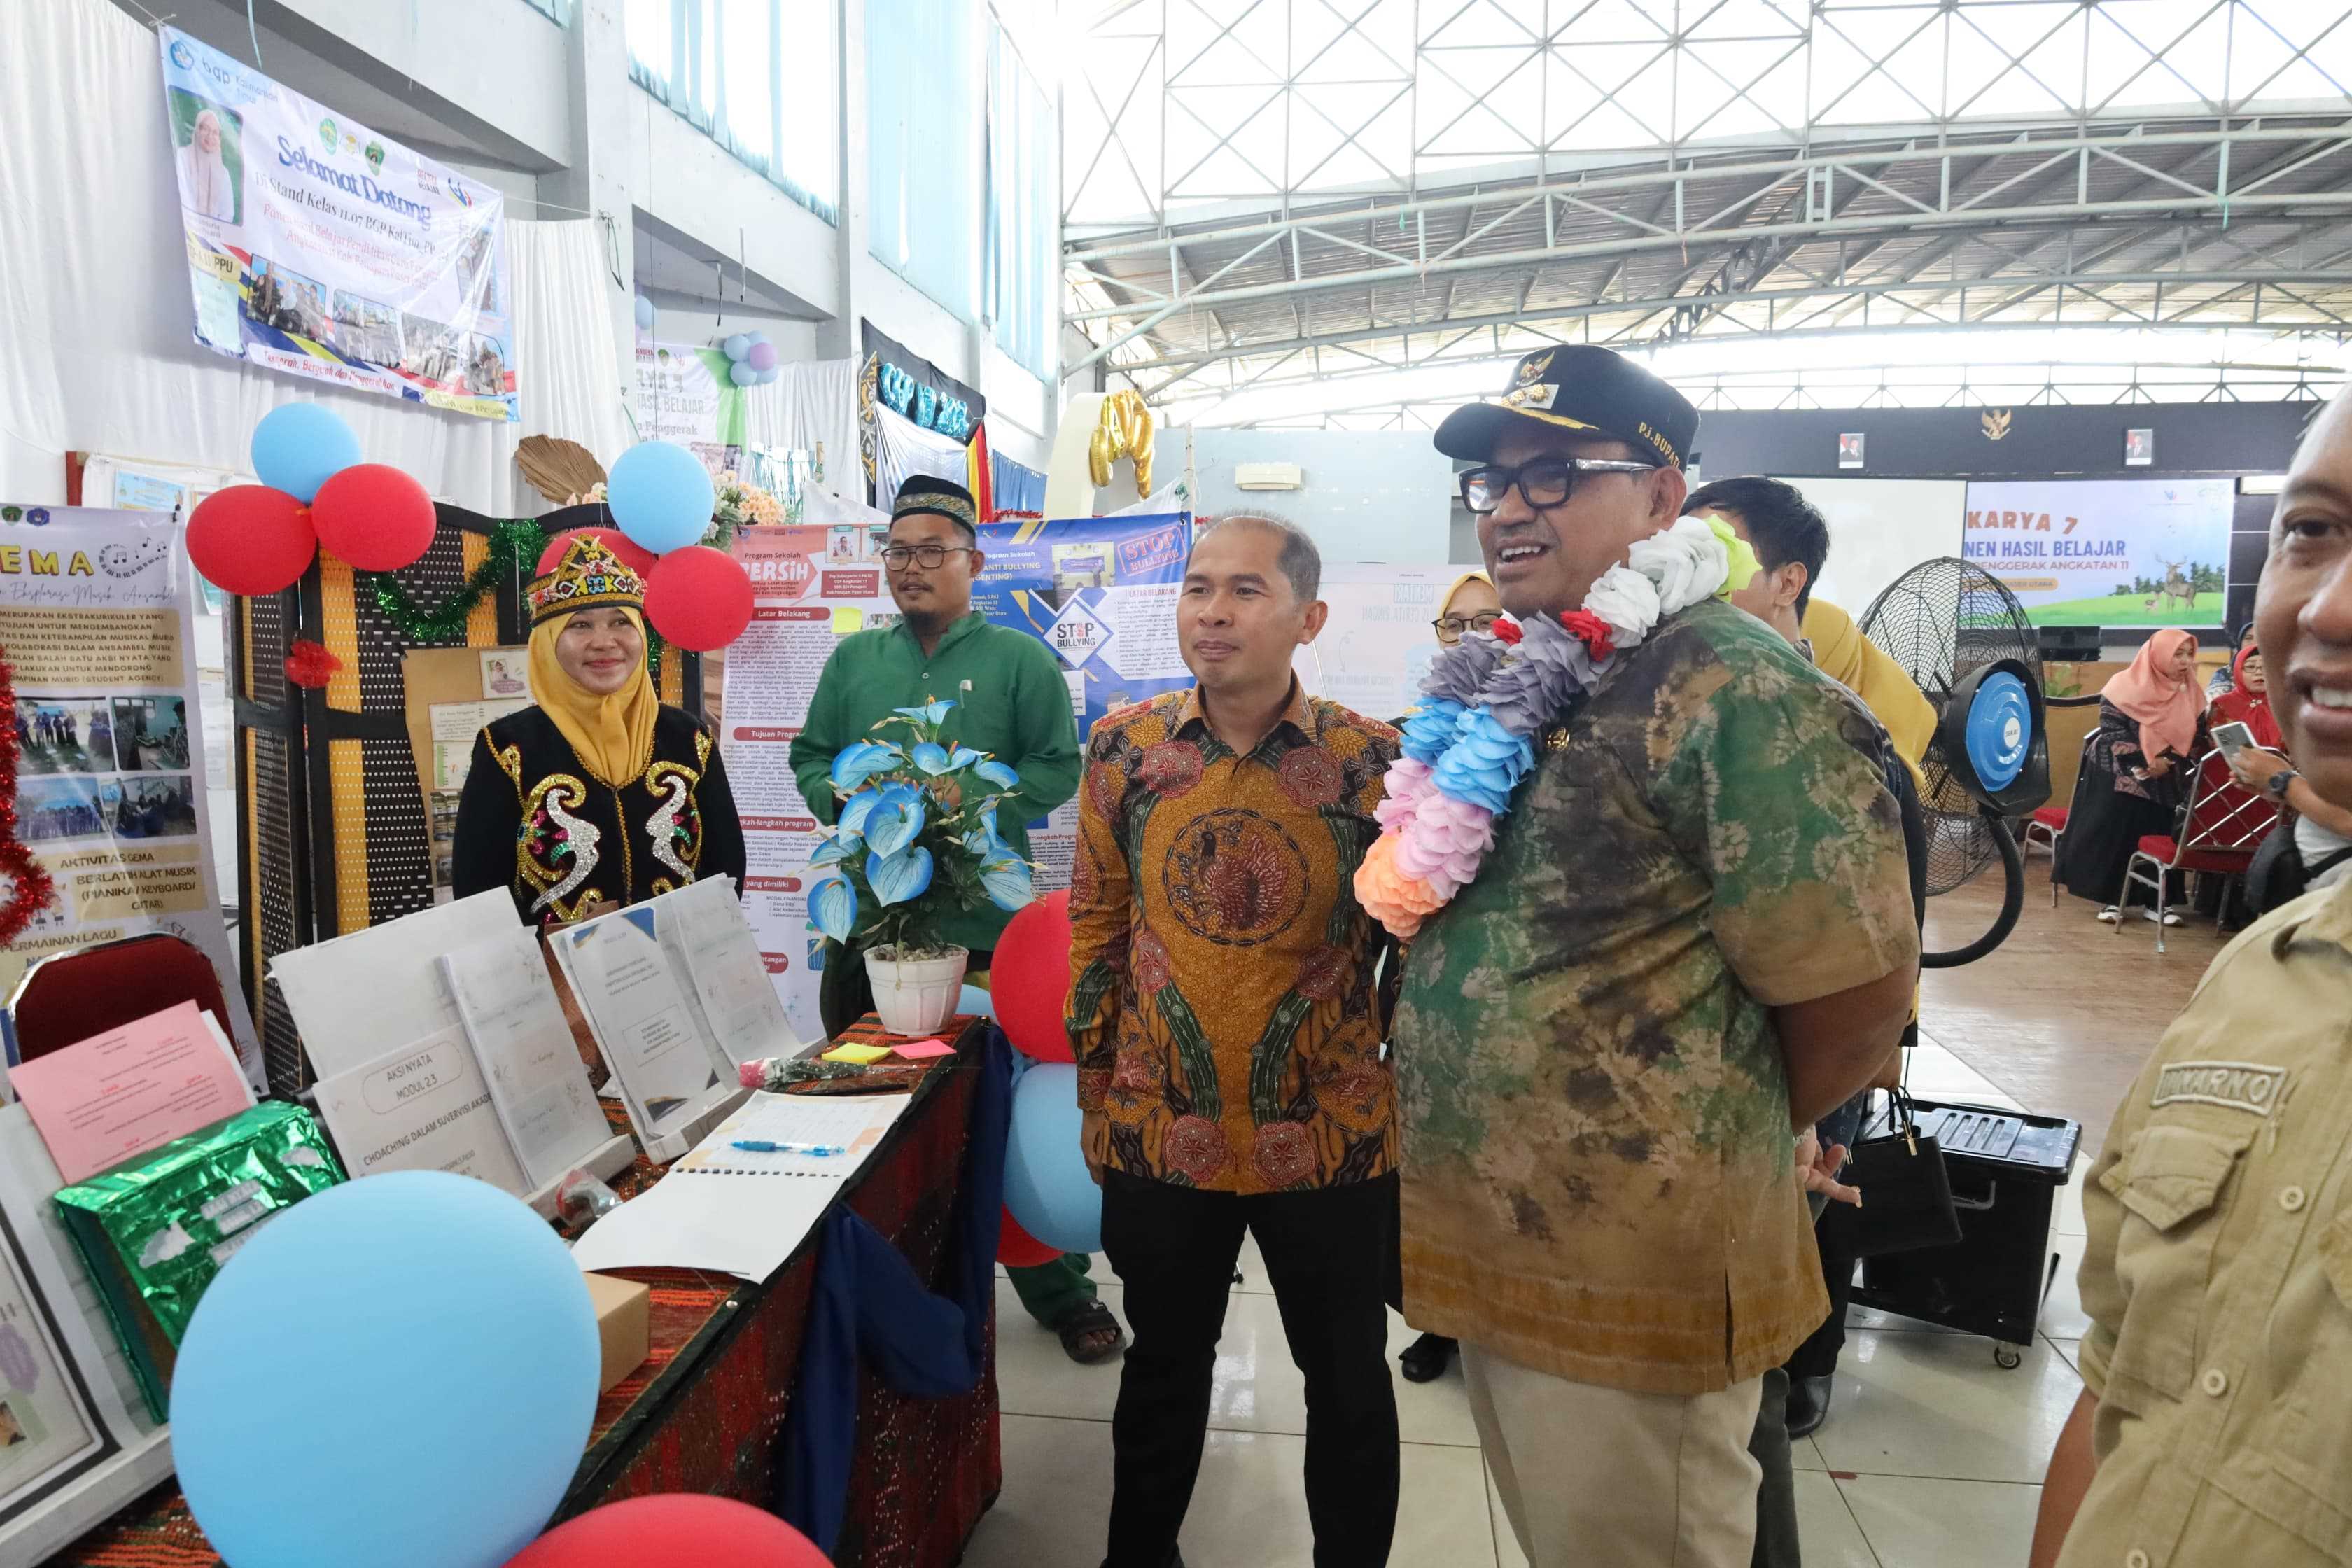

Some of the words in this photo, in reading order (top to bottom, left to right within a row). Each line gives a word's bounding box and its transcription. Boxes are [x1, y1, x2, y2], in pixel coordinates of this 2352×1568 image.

[277, 135, 362, 198] Selamat
[360, 175, 431, 231] Datang
[270, 178, 303, 203] Stand
[307, 192, 336, 216] Kelas
[340, 208, 363, 227] 11.07
[366, 216, 386, 234] BGP
[215, 257, 232, 273] PPU
[666, 398, 704, 414] BELAJAR
[646, 421, 698, 435] Penggerak
[1967, 511, 2051, 532] KARYA
[2062, 517, 2078, 535] 7
[1125, 531, 1174, 560] STOP
[2001, 541, 2047, 556] HASIL
[2053, 540, 2126, 556] BELAJAR
[1003, 562, 1041, 570] BULLYING
[1130, 549, 1180, 571] BULLYING
[2050, 561, 2118, 570] ANGKATAN
[2121, 561, 2129, 570] 11
[1148, 588, 1176, 596] BELAKANG
[1057, 638, 1096, 648] BULLYING
[61, 854, 126, 868] AKTIVITAS
[128, 853, 154, 862] GEMA
[77, 872, 137, 885] BERLATIH
[165, 867, 196, 876] MUSIK
[83, 930, 117, 941] LAGU
[386, 1065, 406, 1082] AKSI
[406, 1054, 433, 1074] NYATA
[396, 1082, 425, 1100] MODUL
[363, 1135, 410, 1166] CHOACHING
[410, 1121, 437, 1141] DALAM
[437, 1103, 470, 1128] SUVERVISI
